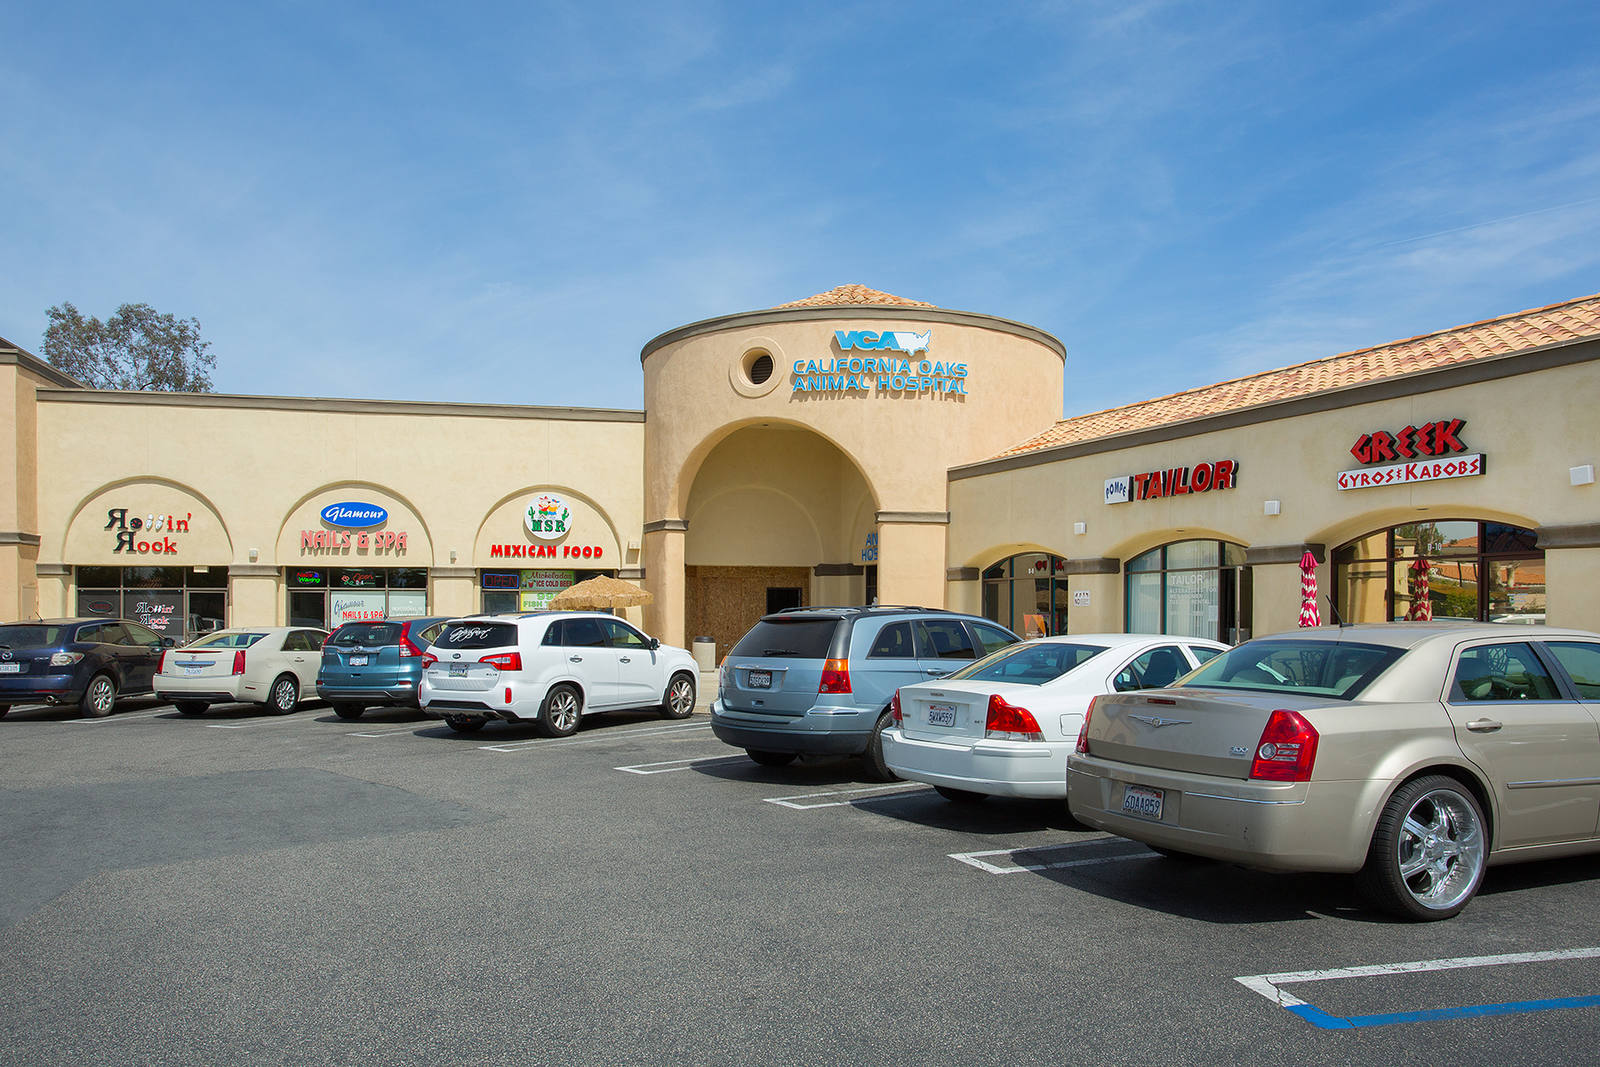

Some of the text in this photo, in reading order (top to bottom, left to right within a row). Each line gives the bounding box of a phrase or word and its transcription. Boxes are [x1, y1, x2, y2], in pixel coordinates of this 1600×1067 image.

[835, 331, 900, 350] VCA
[793, 358, 968, 377] CALIFORNIA OAKS
[793, 375, 968, 394] ANIMAL HOSPITAL
[1350, 418, 1466, 464] GREEK
[1135, 460, 1236, 500] TAILOR
[1338, 469, 1394, 488] GYROS
[1405, 458, 1479, 481] KABOBS
[1106, 481, 1127, 499] POMPE
[325, 507, 384, 522] Glamour
[531, 520, 566, 532] MSR
[114, 531, 178, 553] Rock
[301, 530, 408, 549] NAILS & SPA
[491, 545, 603, 557] MEXICAN FOOD
[485, 575, 517, 587] OPEN
[1171, 575, 1203, 585] TAILOR
[343, 611, 383, 619] NAILS & SPA
[1124, 795, 1161, 814] 6DAA859
